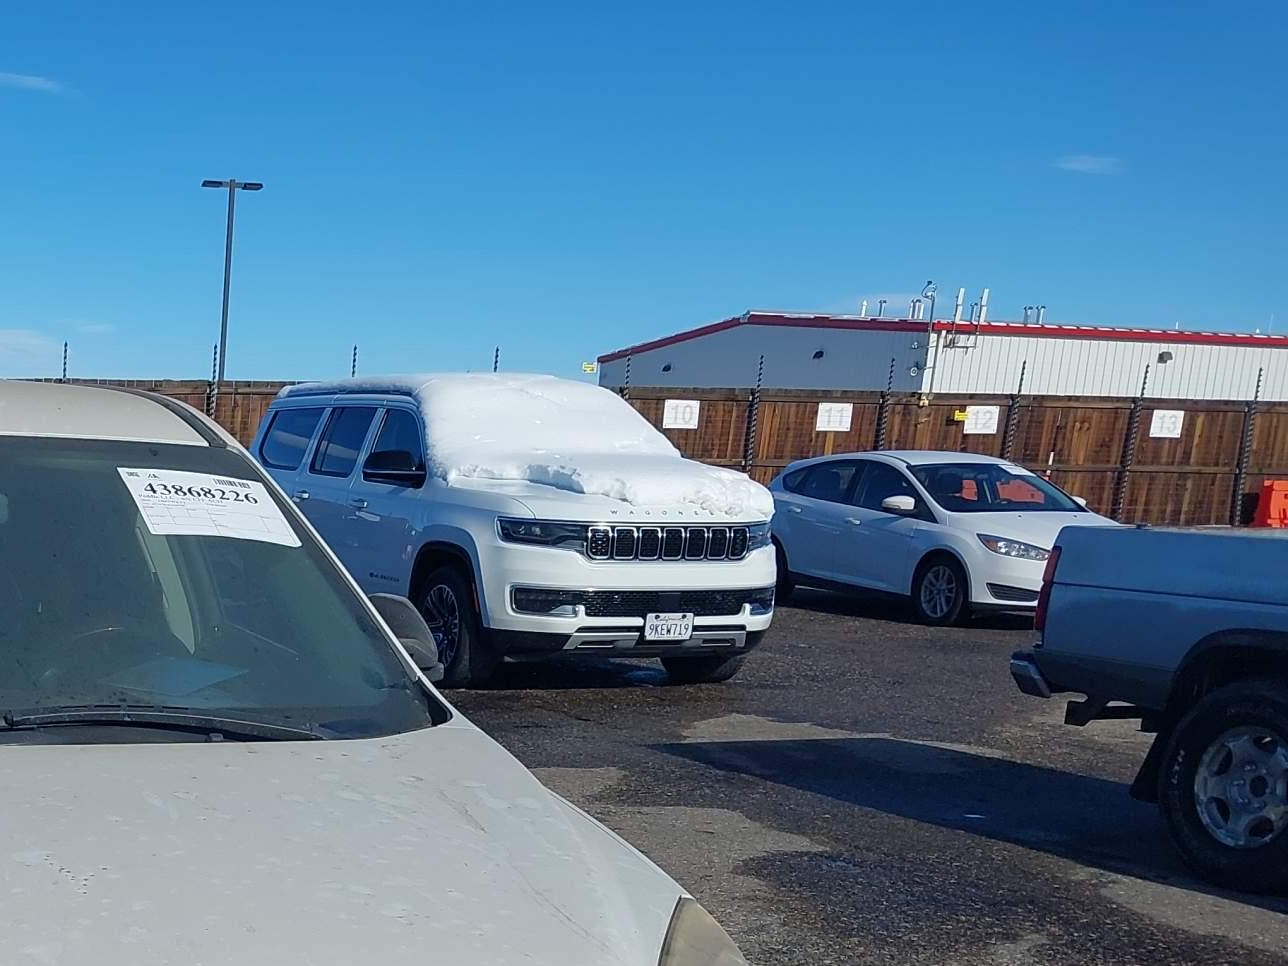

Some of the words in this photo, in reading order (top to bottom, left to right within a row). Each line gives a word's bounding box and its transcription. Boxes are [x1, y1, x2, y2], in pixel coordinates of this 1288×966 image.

[670, 404, 694, 425] 10
[824, 406, 845, 426] 11
[971, 409, 993, 431] 12
[1157, 413, 1179, 434] 13
[143, 482, 259, 505] 43868226
[648, 623, 690, 636] 9KEW719
